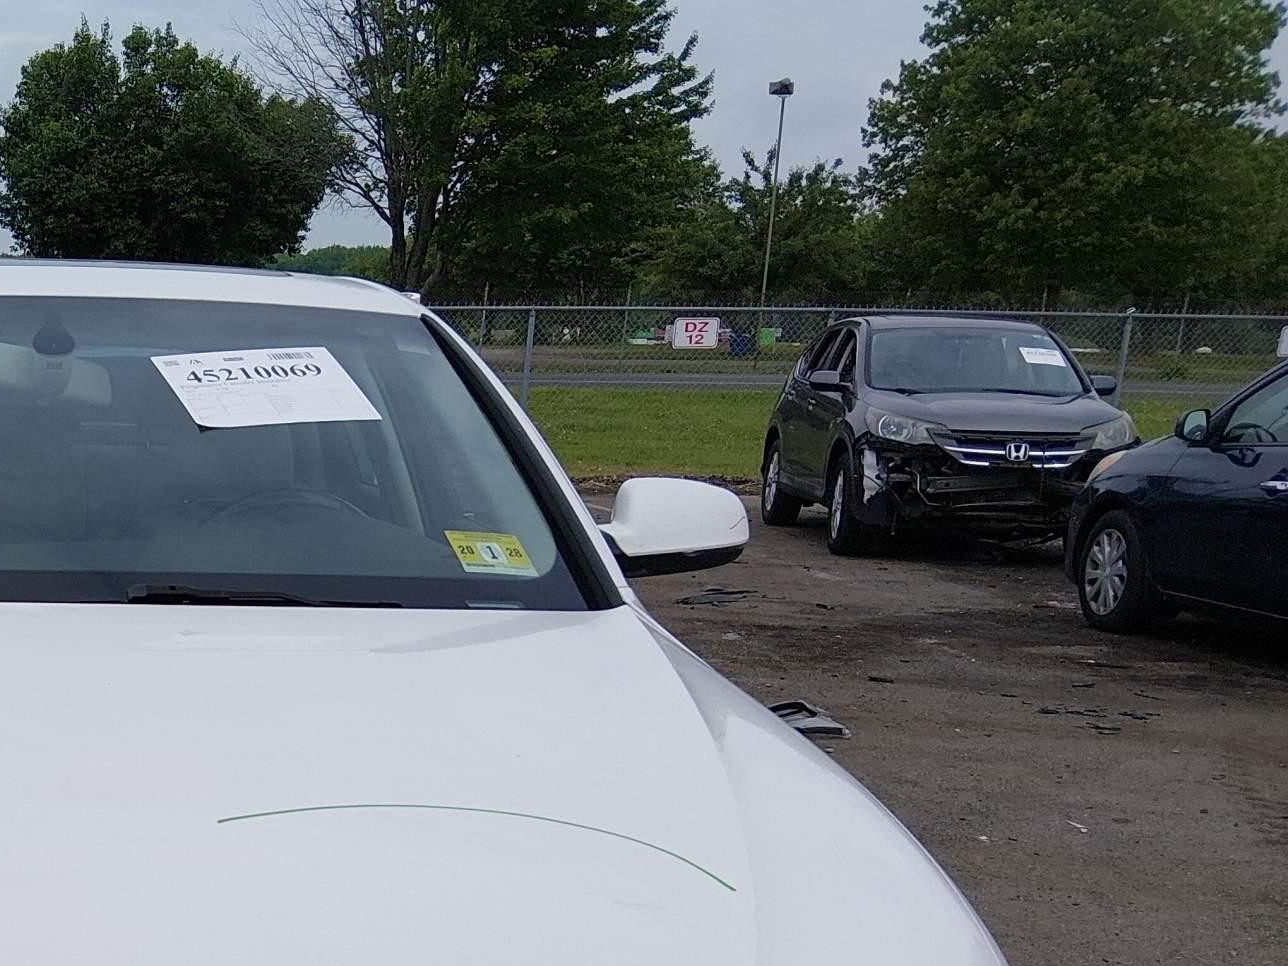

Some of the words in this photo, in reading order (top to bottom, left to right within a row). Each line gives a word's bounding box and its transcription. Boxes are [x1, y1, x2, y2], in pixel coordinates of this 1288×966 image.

[685, 322, 709, 333] DZ
[686, 334, 704, 345] 12
[186, 363, 322, 384] 45210069
[458, 545, 475, 555] 20
[486, 545, 498, 560] 1
[505, 547, 523, 558] 28
